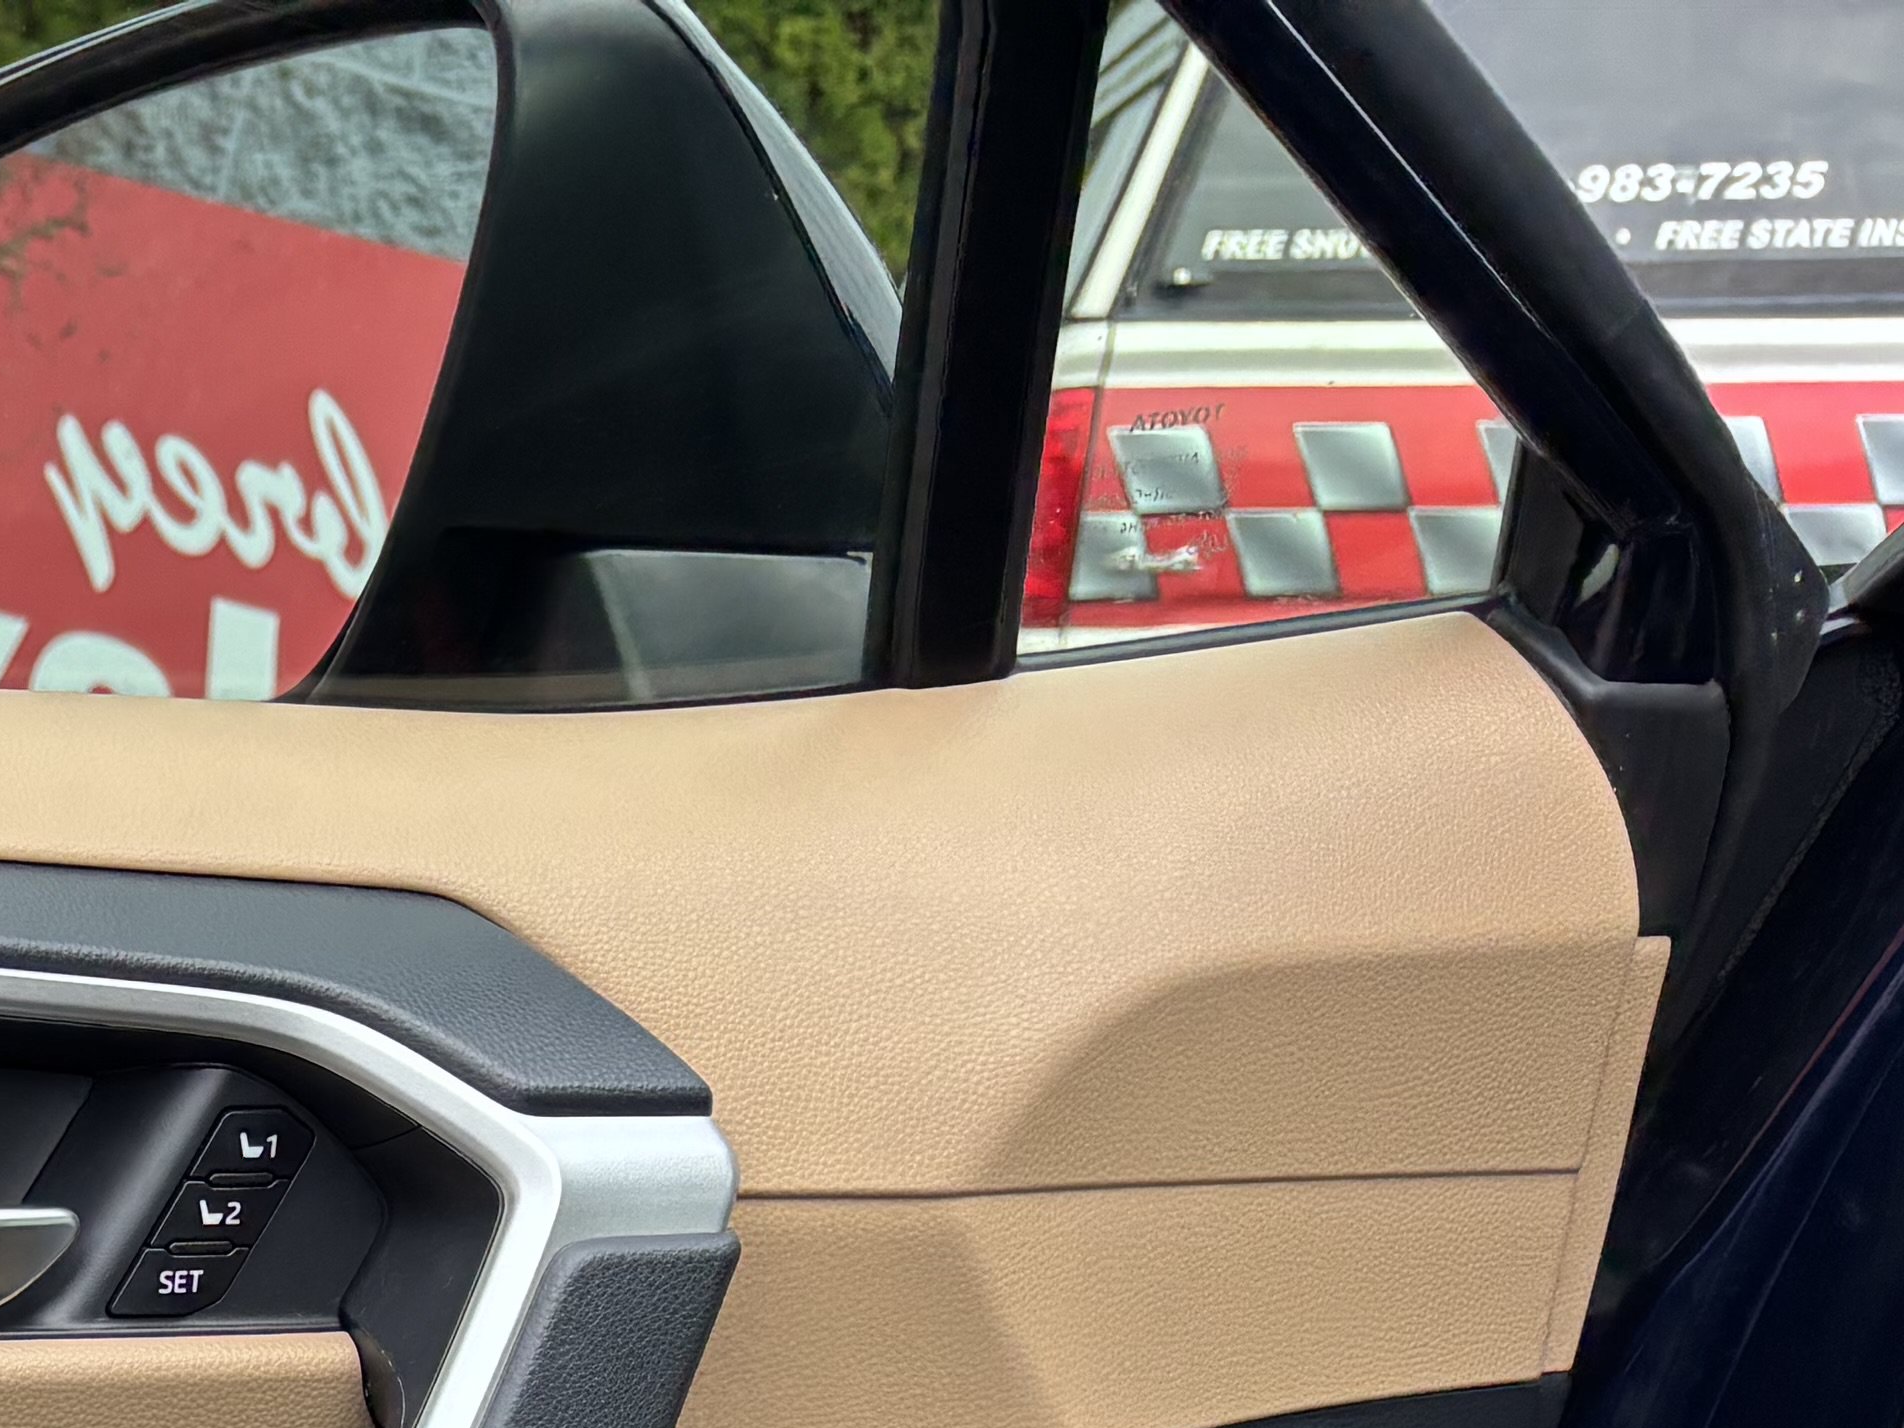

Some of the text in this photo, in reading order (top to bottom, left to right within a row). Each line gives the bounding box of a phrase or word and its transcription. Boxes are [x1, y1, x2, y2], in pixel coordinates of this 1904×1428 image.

[1201, 228, 1289, 260] FREE
[1655, 220, 1744, 250] FREE
[1746, 219, 1855, 249] STATE
[265, 1134, 278, 1159] 1
[225, 1201, 241, 1226] 2
[158, 1269, 204, 1295] SET
